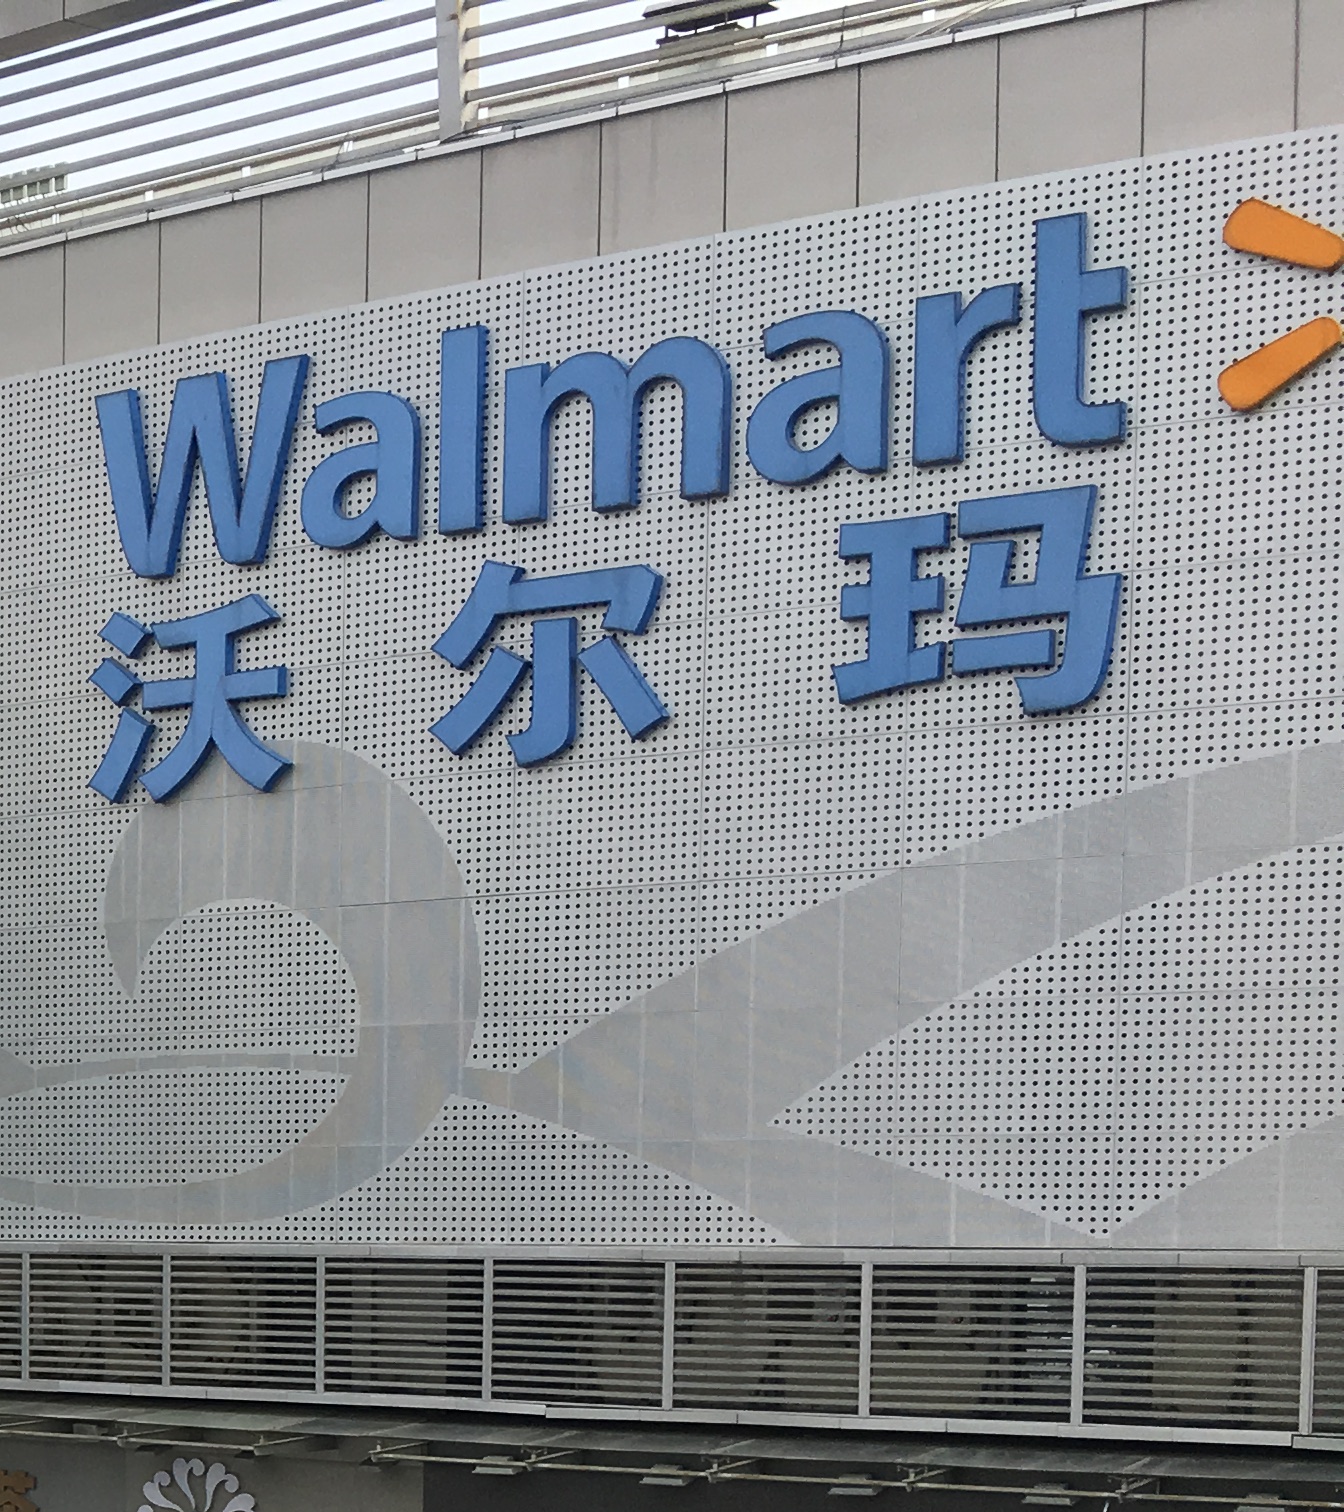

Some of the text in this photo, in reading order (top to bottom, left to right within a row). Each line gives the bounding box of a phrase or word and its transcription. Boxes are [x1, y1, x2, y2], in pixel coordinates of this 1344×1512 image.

[94, 212, 1129, 580] Walmart
[89, 484, 1124, 801] 沃尔玛
